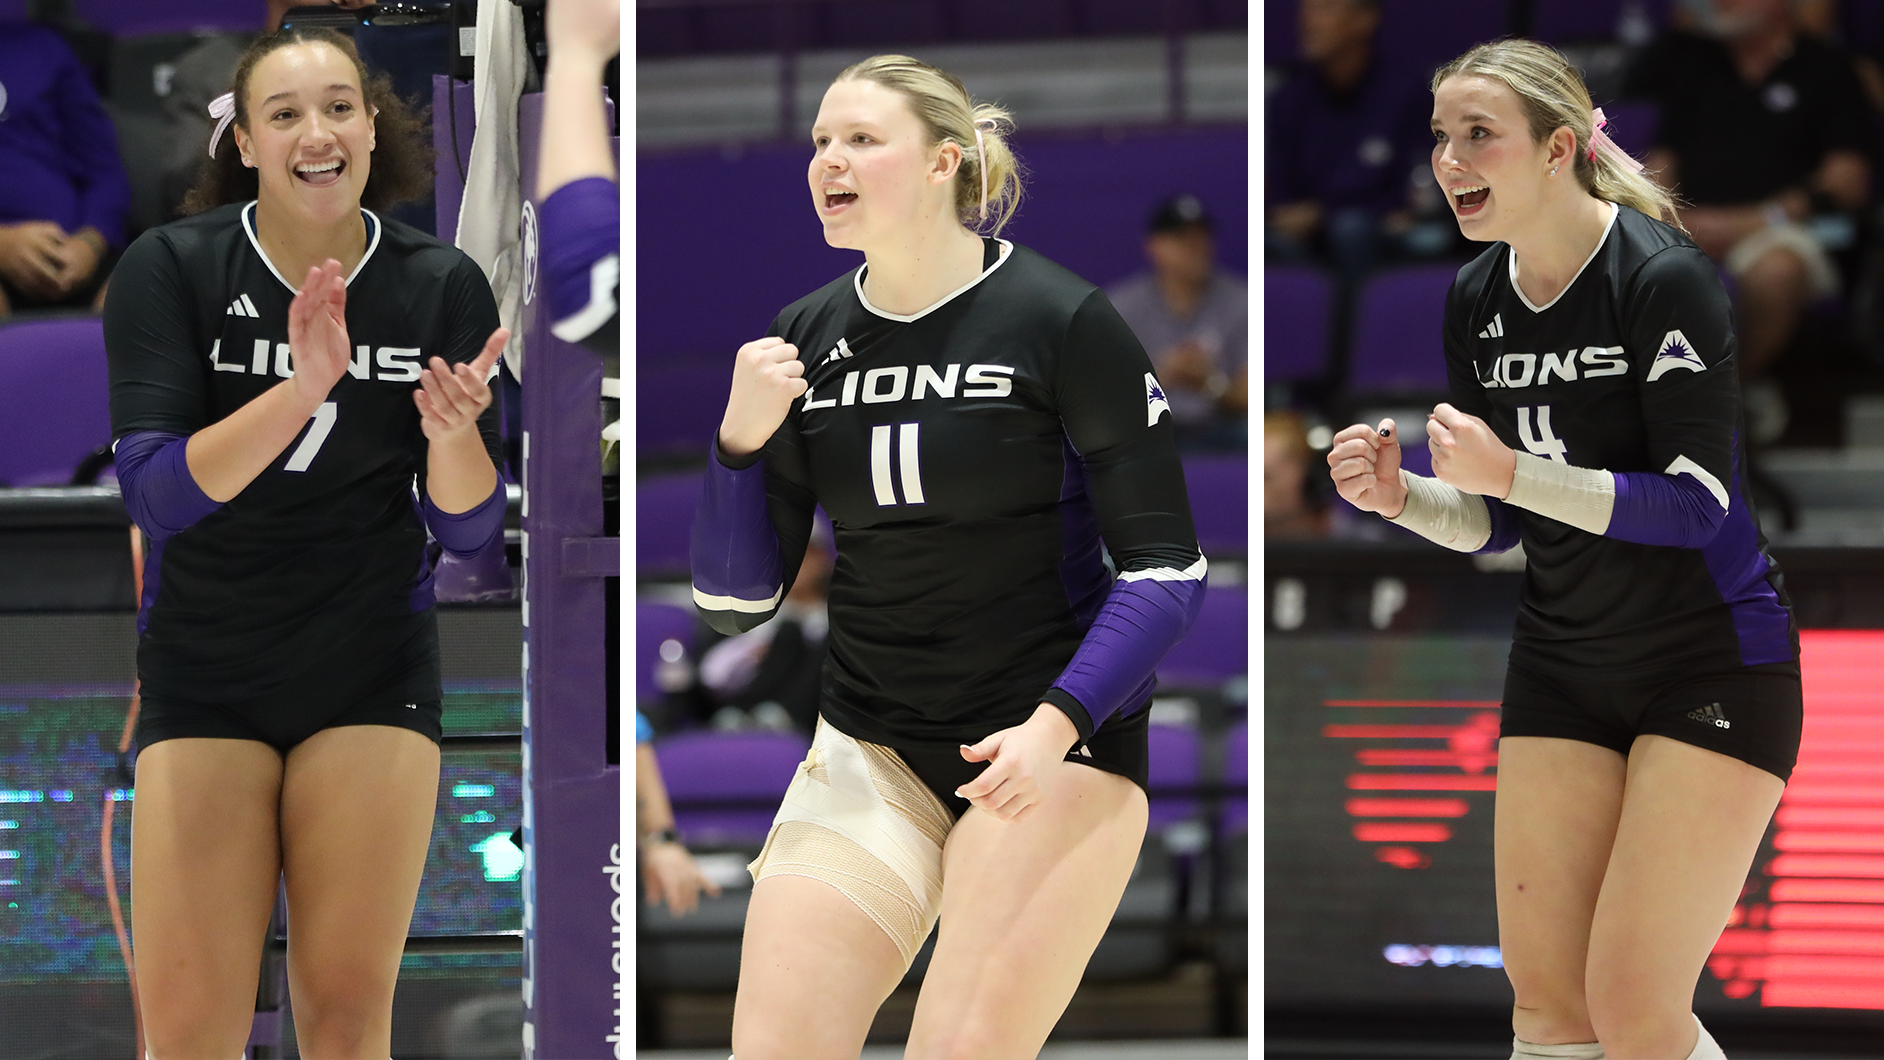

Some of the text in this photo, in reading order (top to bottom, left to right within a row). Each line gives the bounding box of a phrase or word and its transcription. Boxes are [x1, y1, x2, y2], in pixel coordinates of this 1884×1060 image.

[801, 363, 1016, 413] LIONS
[1472, 344, 1630, 390] LIONS
[282, 401, 338, 473] 7
[869, 421, 927, 507] 11
[1516, 404, 1568, 466] 4
